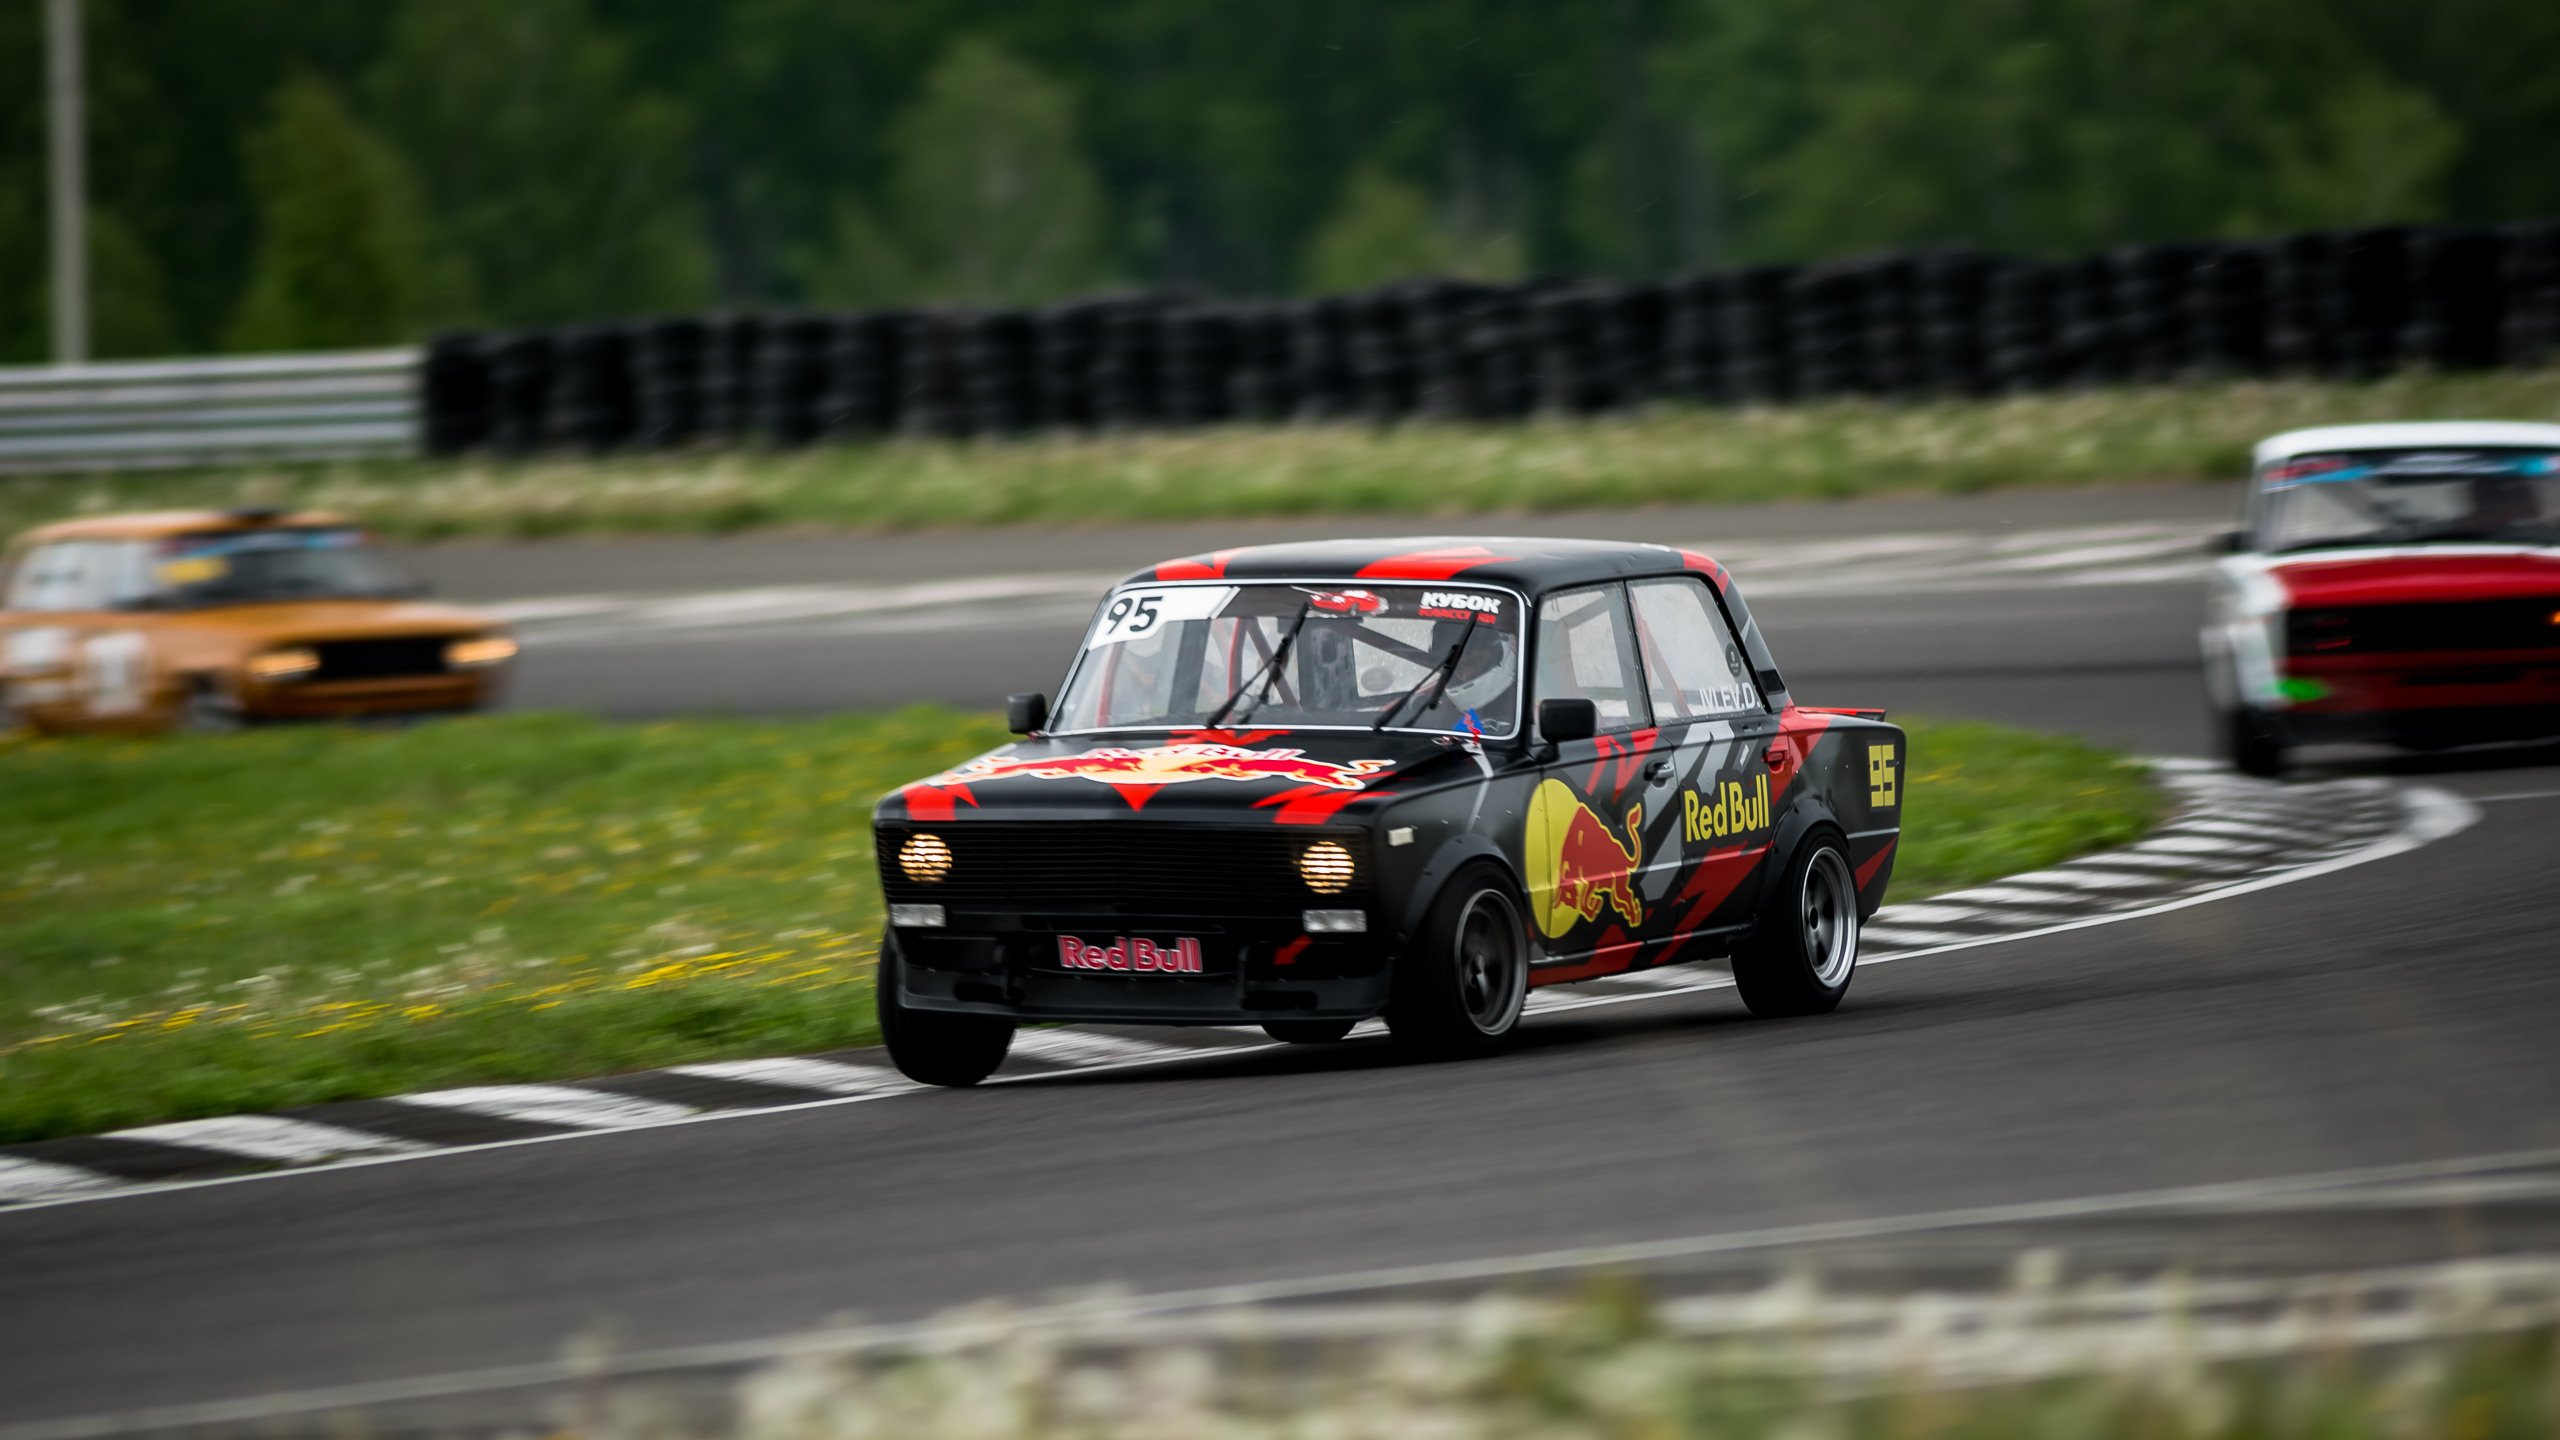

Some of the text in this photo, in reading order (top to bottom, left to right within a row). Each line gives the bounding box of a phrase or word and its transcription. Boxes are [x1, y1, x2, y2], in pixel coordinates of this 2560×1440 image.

[1107, 596, 1163, 634] 95
[1420, 591, 1501, 614] КУБОК
[1869, 745, 1895, 807] 95
[1684, 774, 1769, 842] Red Bull
[1057, 935, 1203, 973] Red Bull
